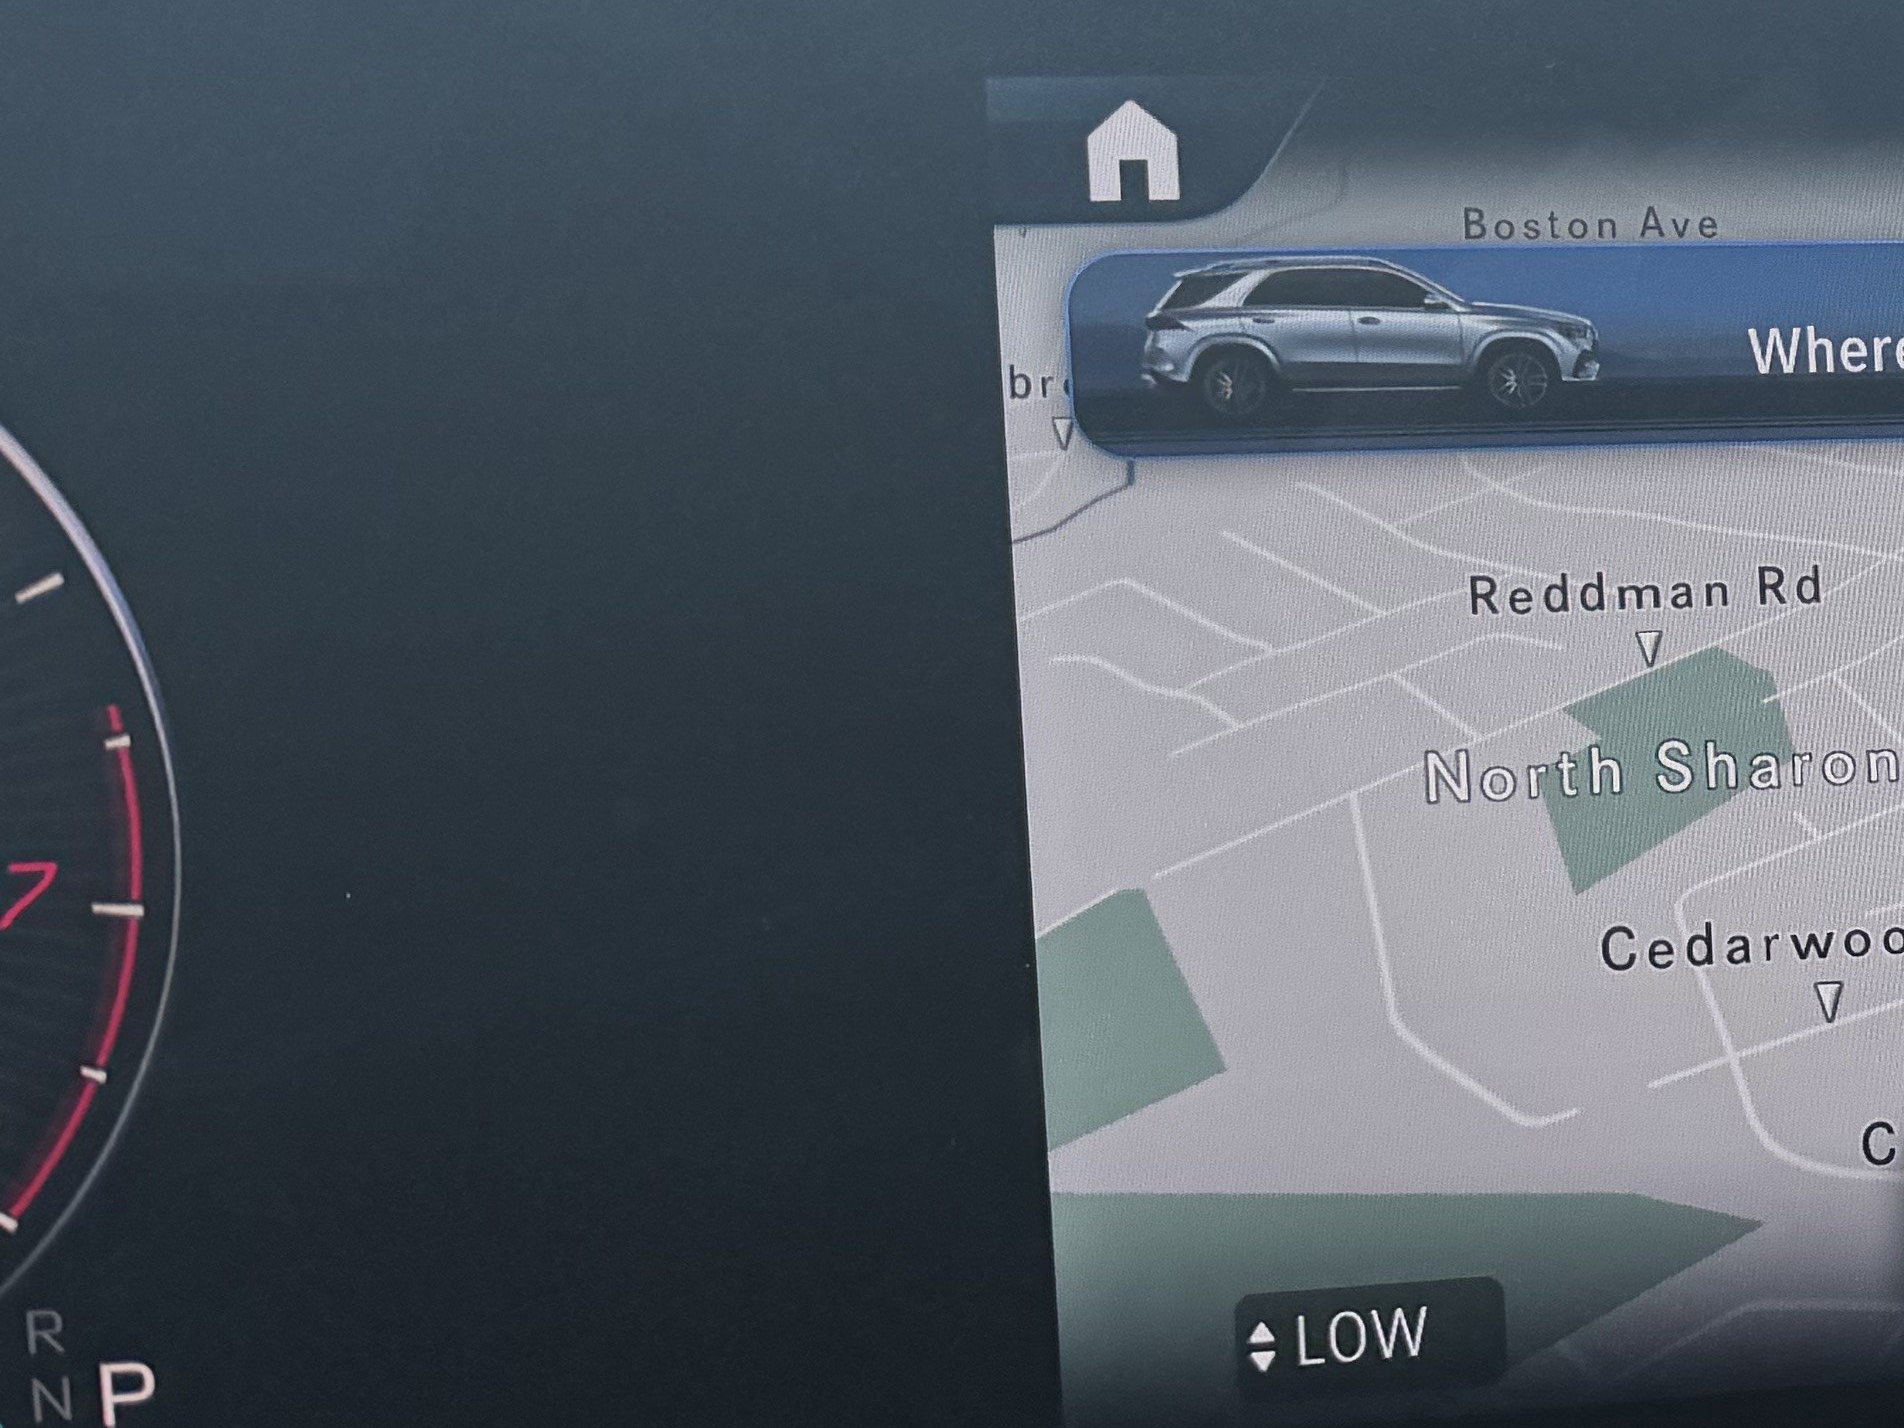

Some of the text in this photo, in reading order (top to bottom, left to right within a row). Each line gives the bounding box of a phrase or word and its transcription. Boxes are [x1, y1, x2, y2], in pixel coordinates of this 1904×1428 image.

[1463, 206, 1720, 241] Boston Ave
[1470, 565, 1823, 617] Reddman Rd
[1425, 743, 1624, 805] North
[1656, 735, 1901, 793] Sharon
[0, 862, 58, 929] 7
[26, 1310, 65, 1355] R
[1297, 1306, 1427, 1369] LOW
[31, 1376, 72, 1423] N
